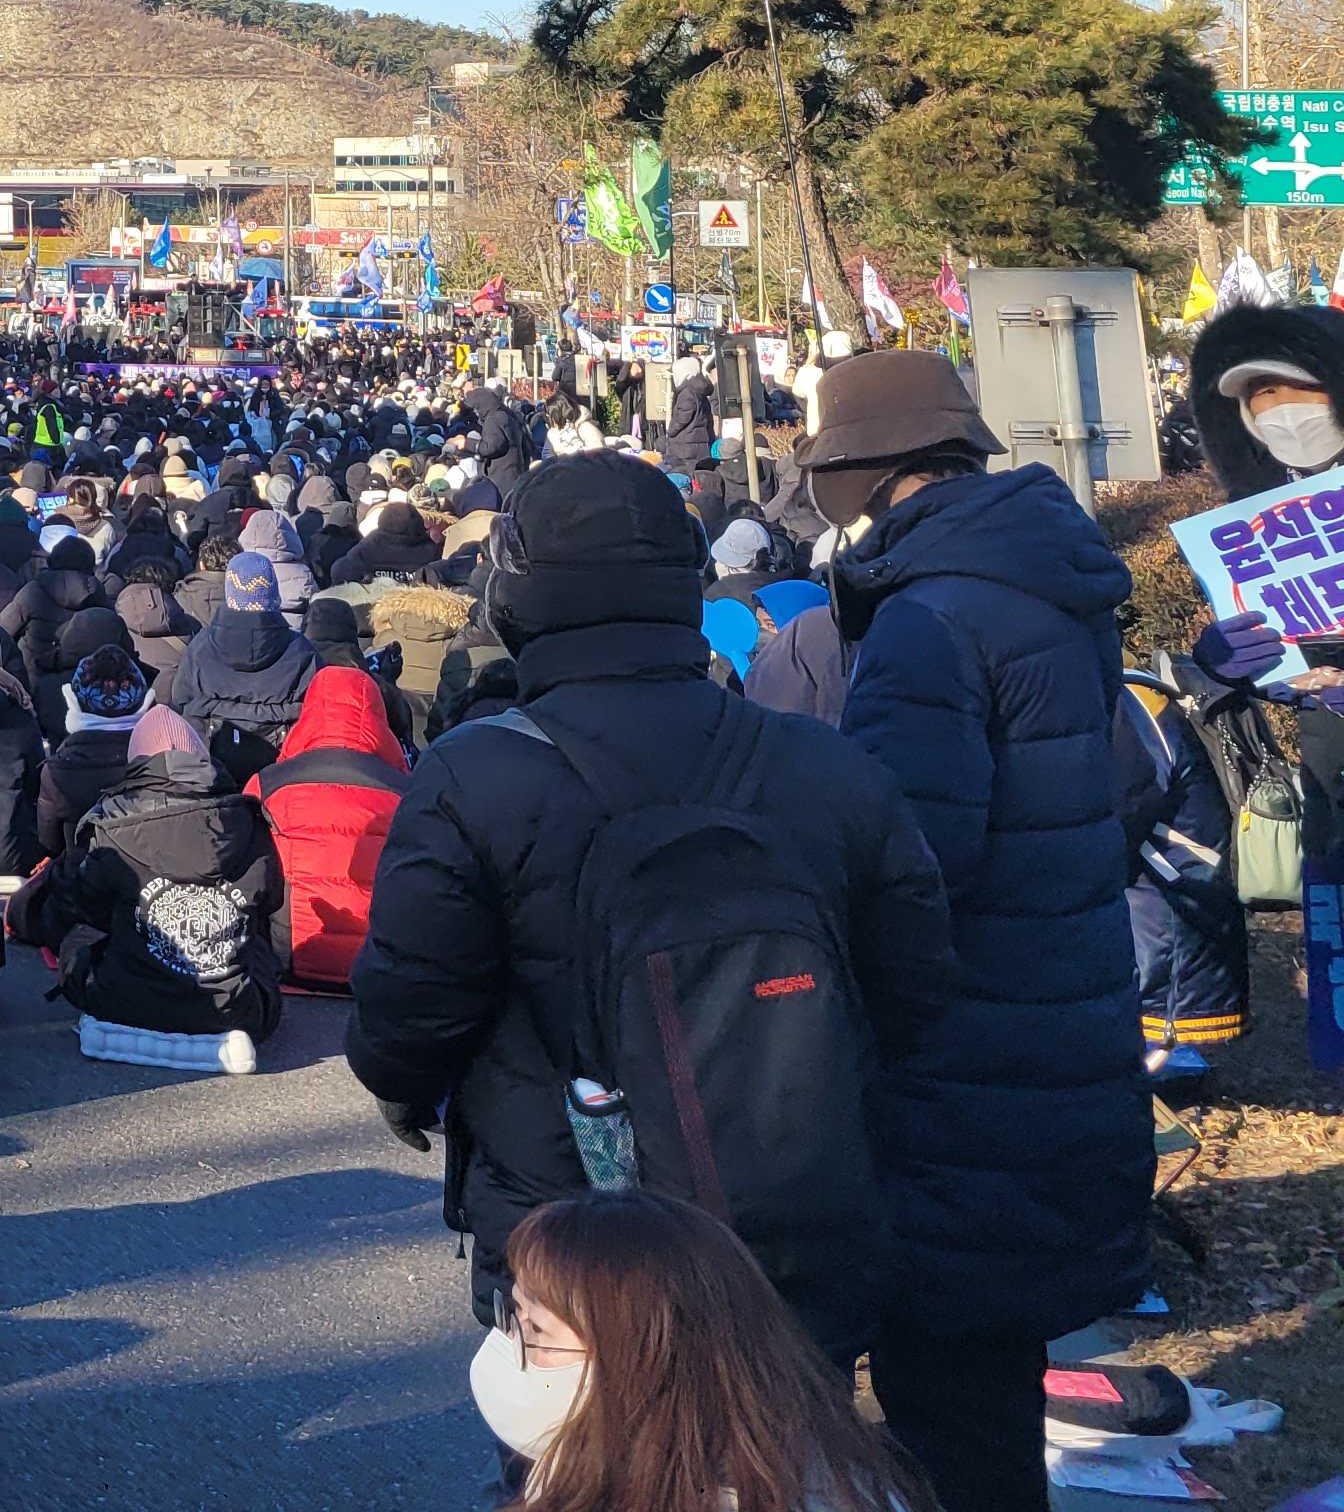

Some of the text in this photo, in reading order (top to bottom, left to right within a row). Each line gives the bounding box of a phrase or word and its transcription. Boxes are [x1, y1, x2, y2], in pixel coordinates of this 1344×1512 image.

[1223, 94, 1295, 112] 국립현충원
[1303, 121, 1329, 133] Isu
[1285, 192, 1324, 203] 150m
